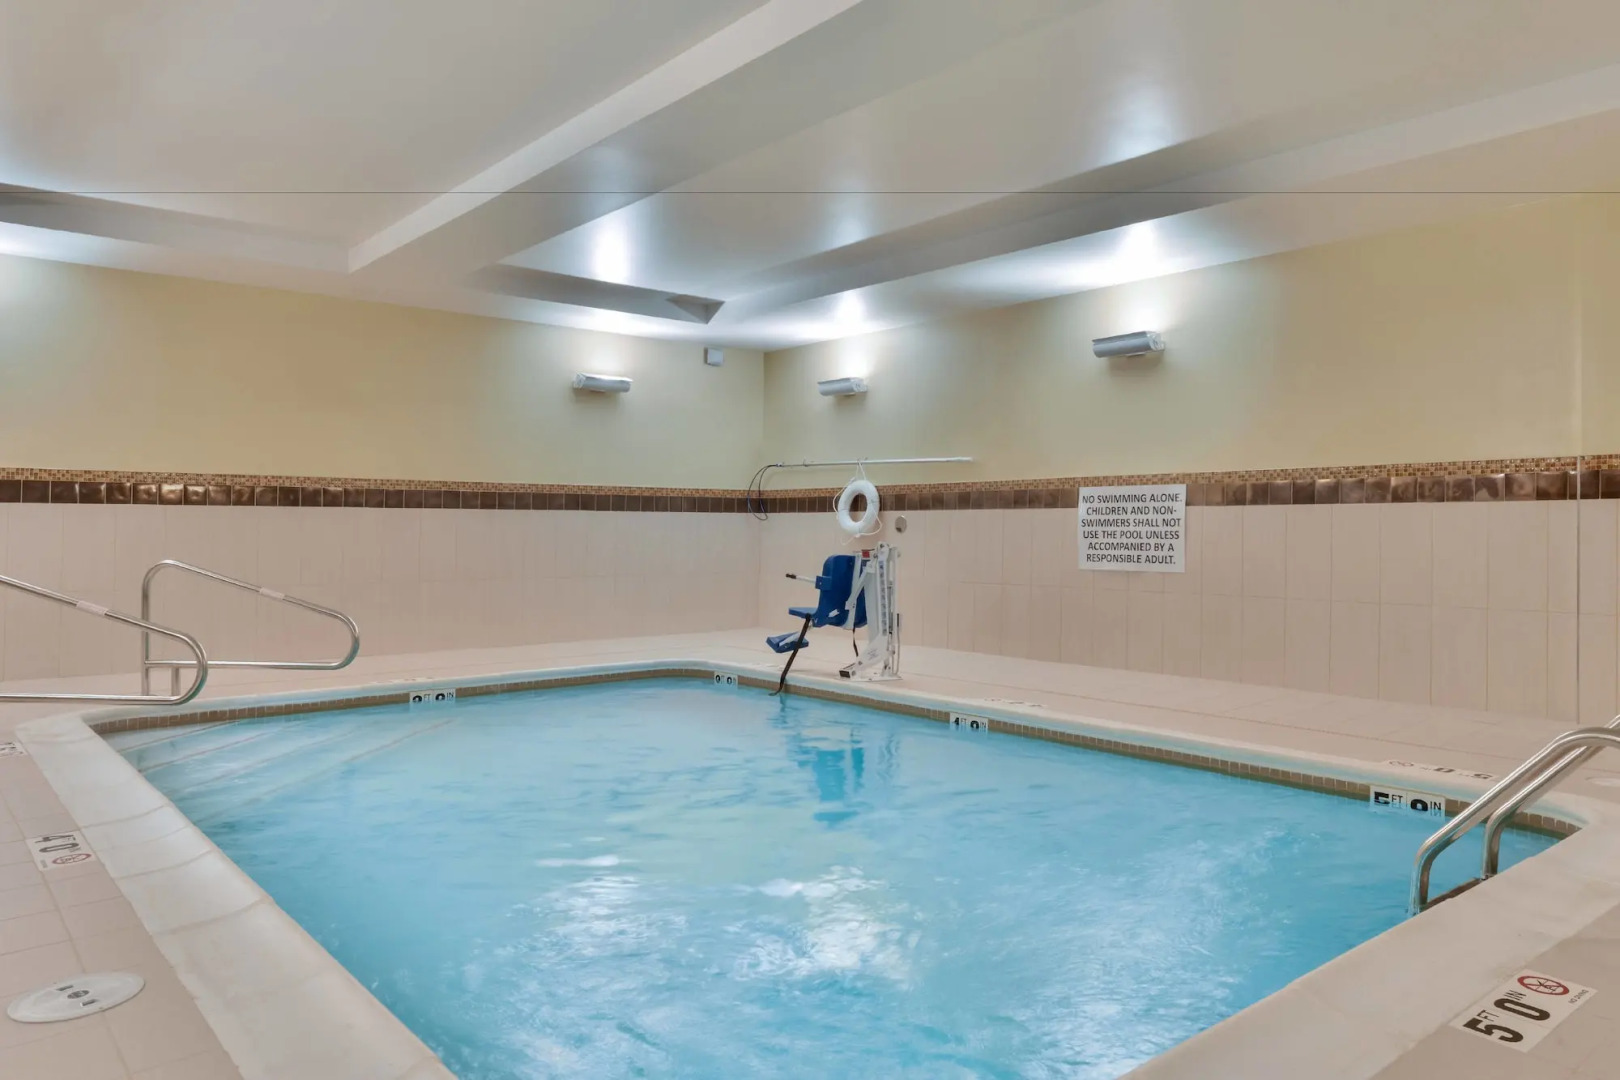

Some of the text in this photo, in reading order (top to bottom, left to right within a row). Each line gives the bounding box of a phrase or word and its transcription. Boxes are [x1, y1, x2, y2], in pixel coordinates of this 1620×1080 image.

[1097, 494, 1147, 503] SWIMMING
[1149, 493, 1182, 502] ALONE.
[1087, 506, 1176, 515] CHILDREN AND NON-
[1081, 518, 1181, 527] SWIMMERS SHALL NOT
[1083, 530, 1179, 539] USE THE POOL UNLESS
[1088, 542, 1174, 552] ACCOMPANIED BY A
[1087, 554, 1175, 564] RESPONSIBLE ADULT.
[1391, 794, 1403, 805] FT
[1430, 801, 1442, 811] IN
[1462, 989, 1551, 1043] 5 FT 0 IN
